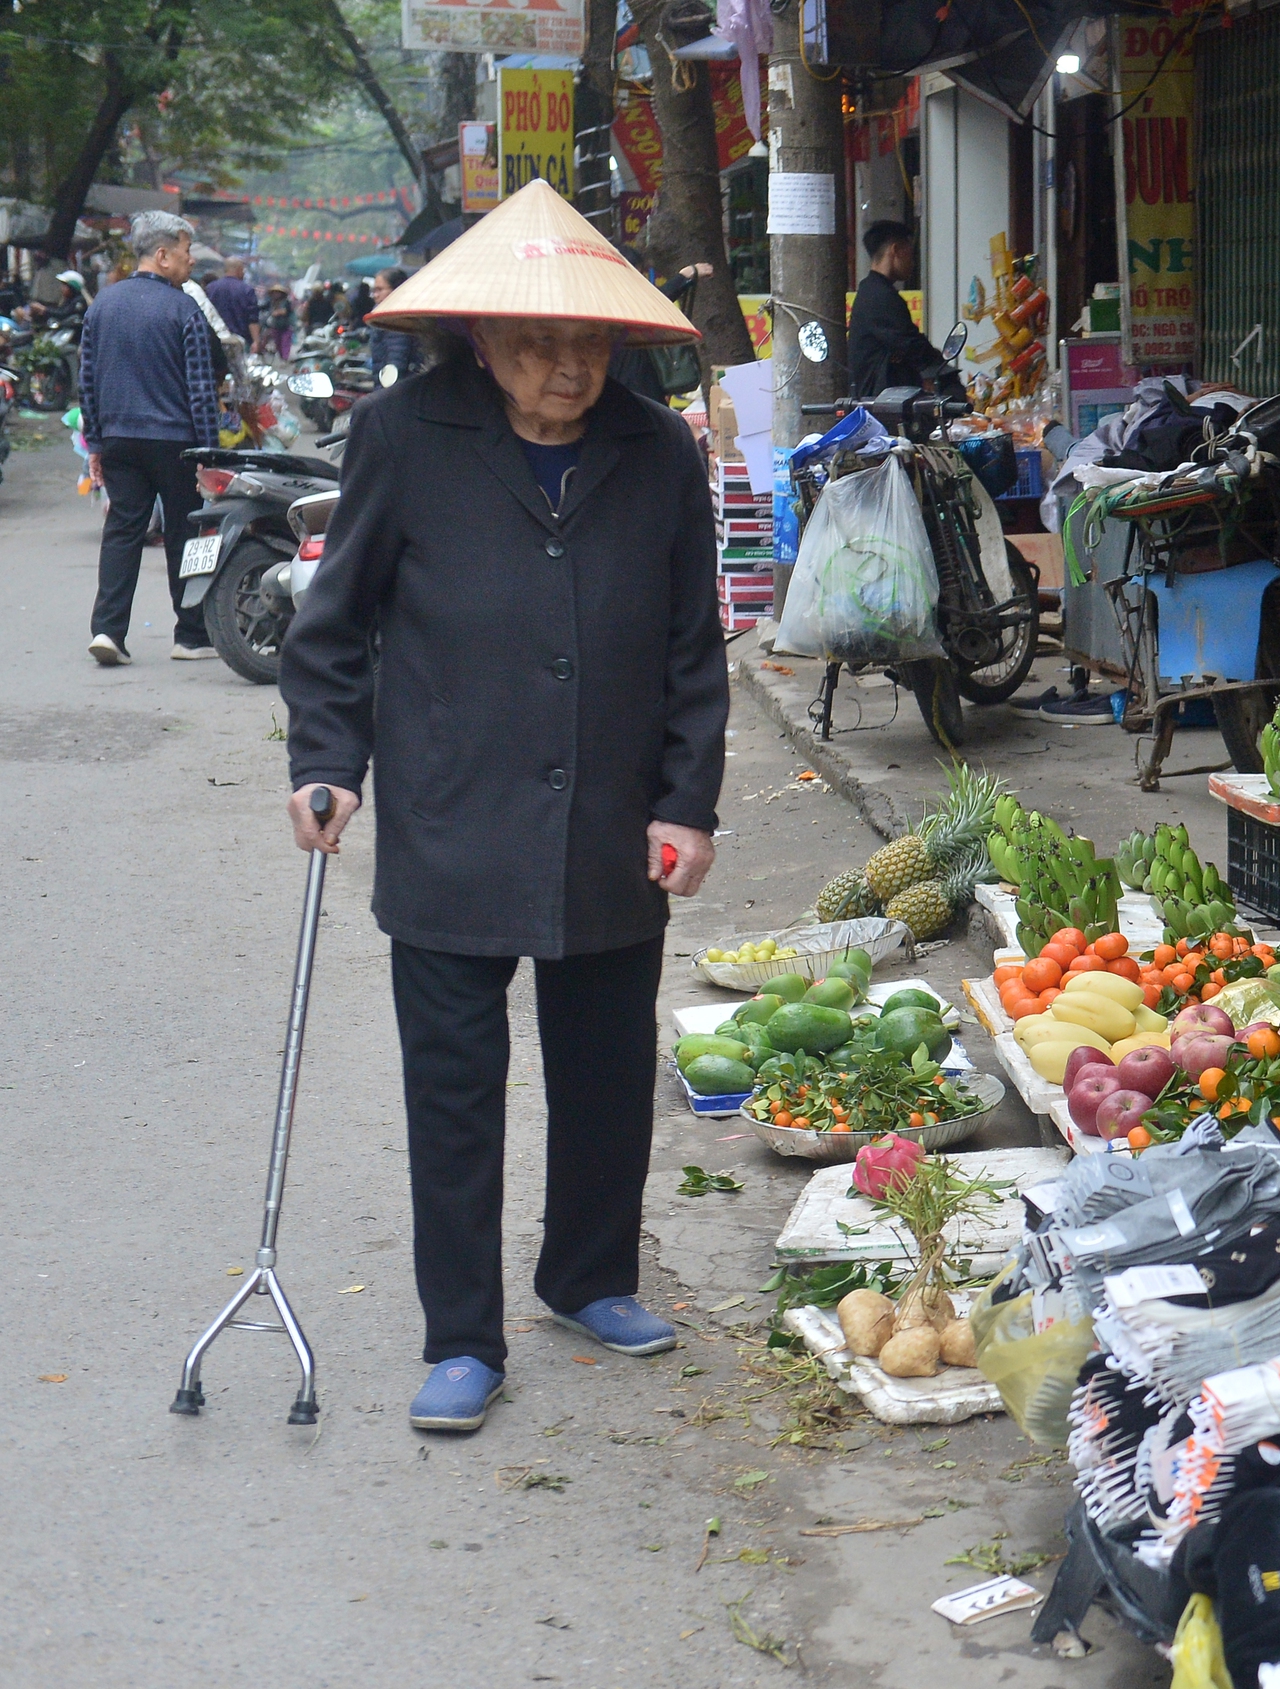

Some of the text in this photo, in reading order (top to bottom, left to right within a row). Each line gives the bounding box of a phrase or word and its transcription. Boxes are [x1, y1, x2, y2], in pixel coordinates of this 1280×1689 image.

[504, 73, 571, 132] PHỞ BÒ
[187, 538, 216, 557] 29-H2
[181, 554, 214, 574] 009.05
